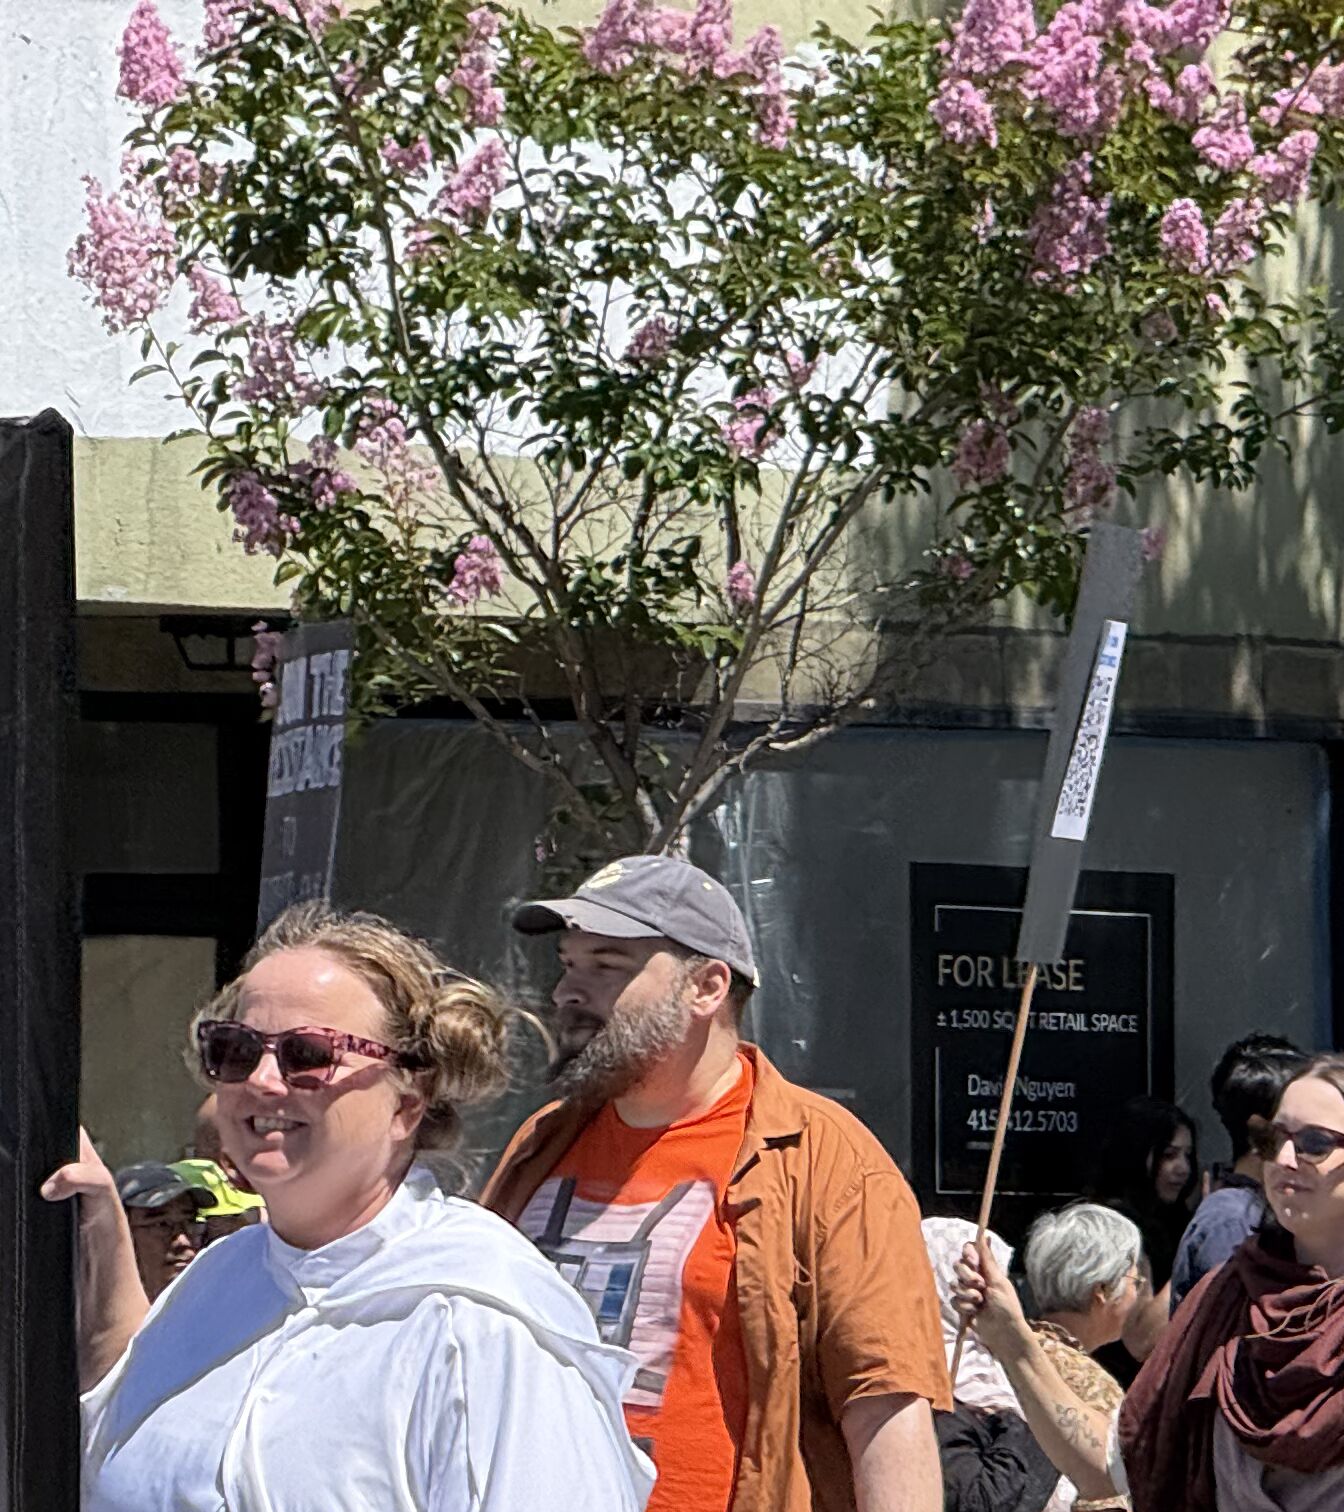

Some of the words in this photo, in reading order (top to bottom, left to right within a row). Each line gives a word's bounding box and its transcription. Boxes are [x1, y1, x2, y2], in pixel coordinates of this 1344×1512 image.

[938, 954, 995, 988] FOR
[1039, 1012, 1088, 1032] RETAIL
[1091, 1014, 1138, 1034] SPACE
[1016, 1075, 1076, 1101] Nguyen
